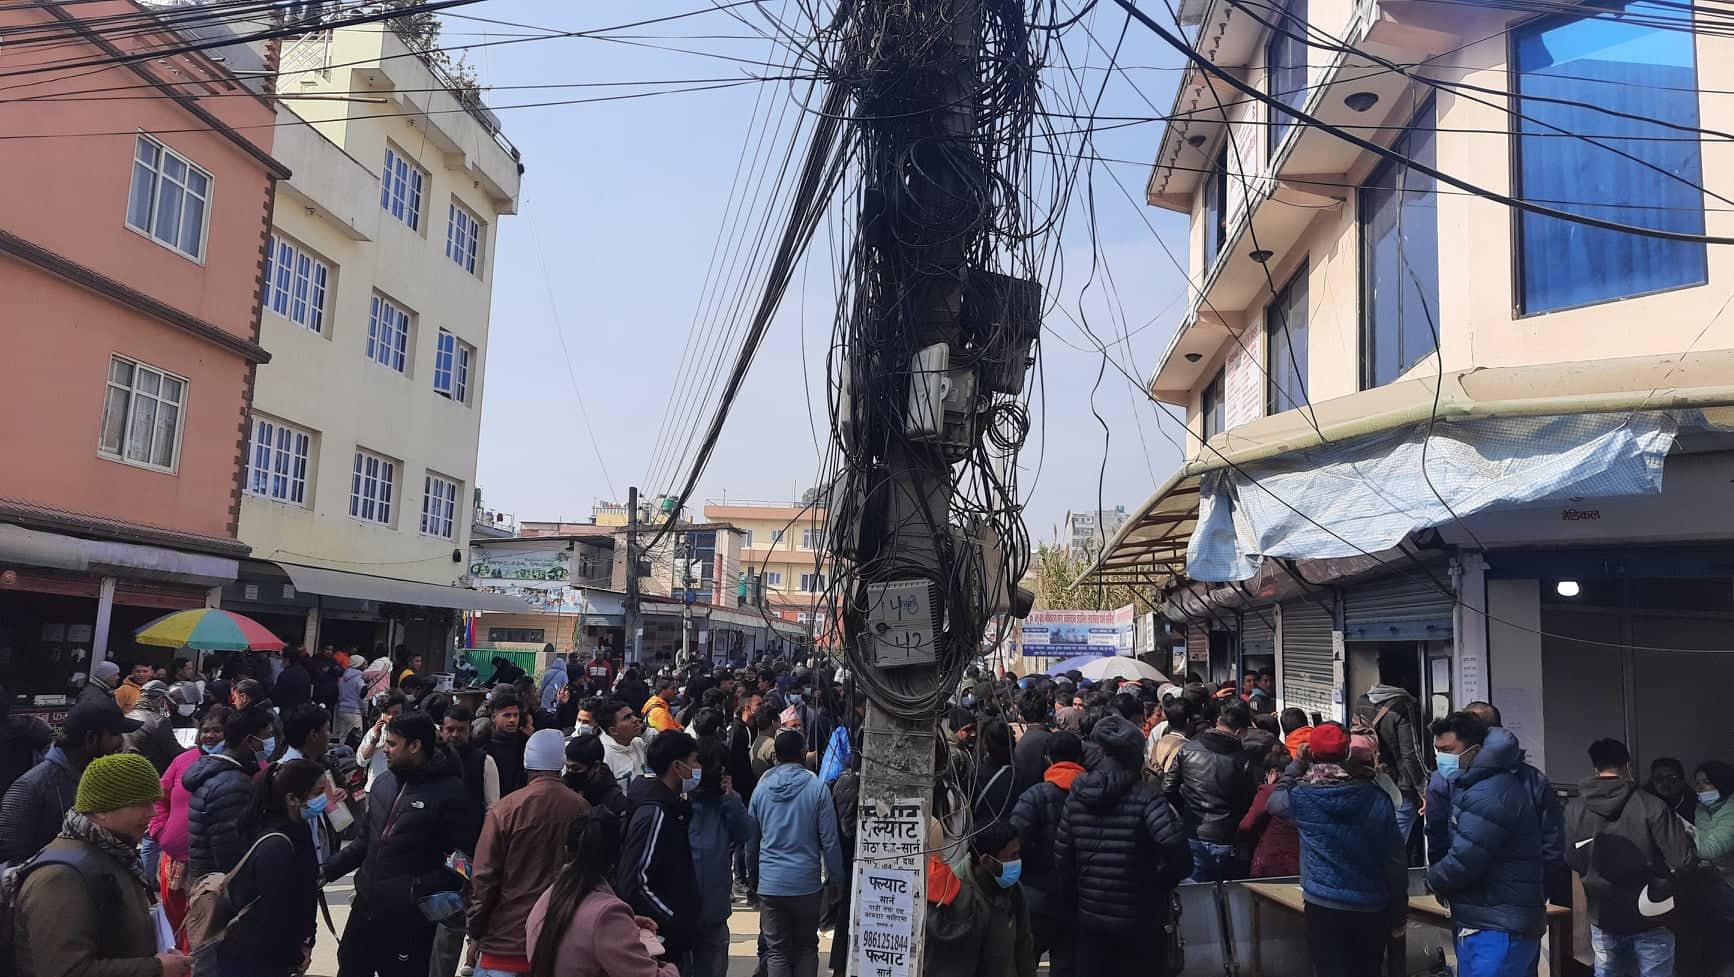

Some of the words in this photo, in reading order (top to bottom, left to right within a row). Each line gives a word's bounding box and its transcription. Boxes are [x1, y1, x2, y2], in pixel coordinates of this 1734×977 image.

[868, 876, 908, 894] फ्ल्याट
[863, 929, 908, 953] 9861251844
[865, 948, 904, 966] फ्ल्याट
